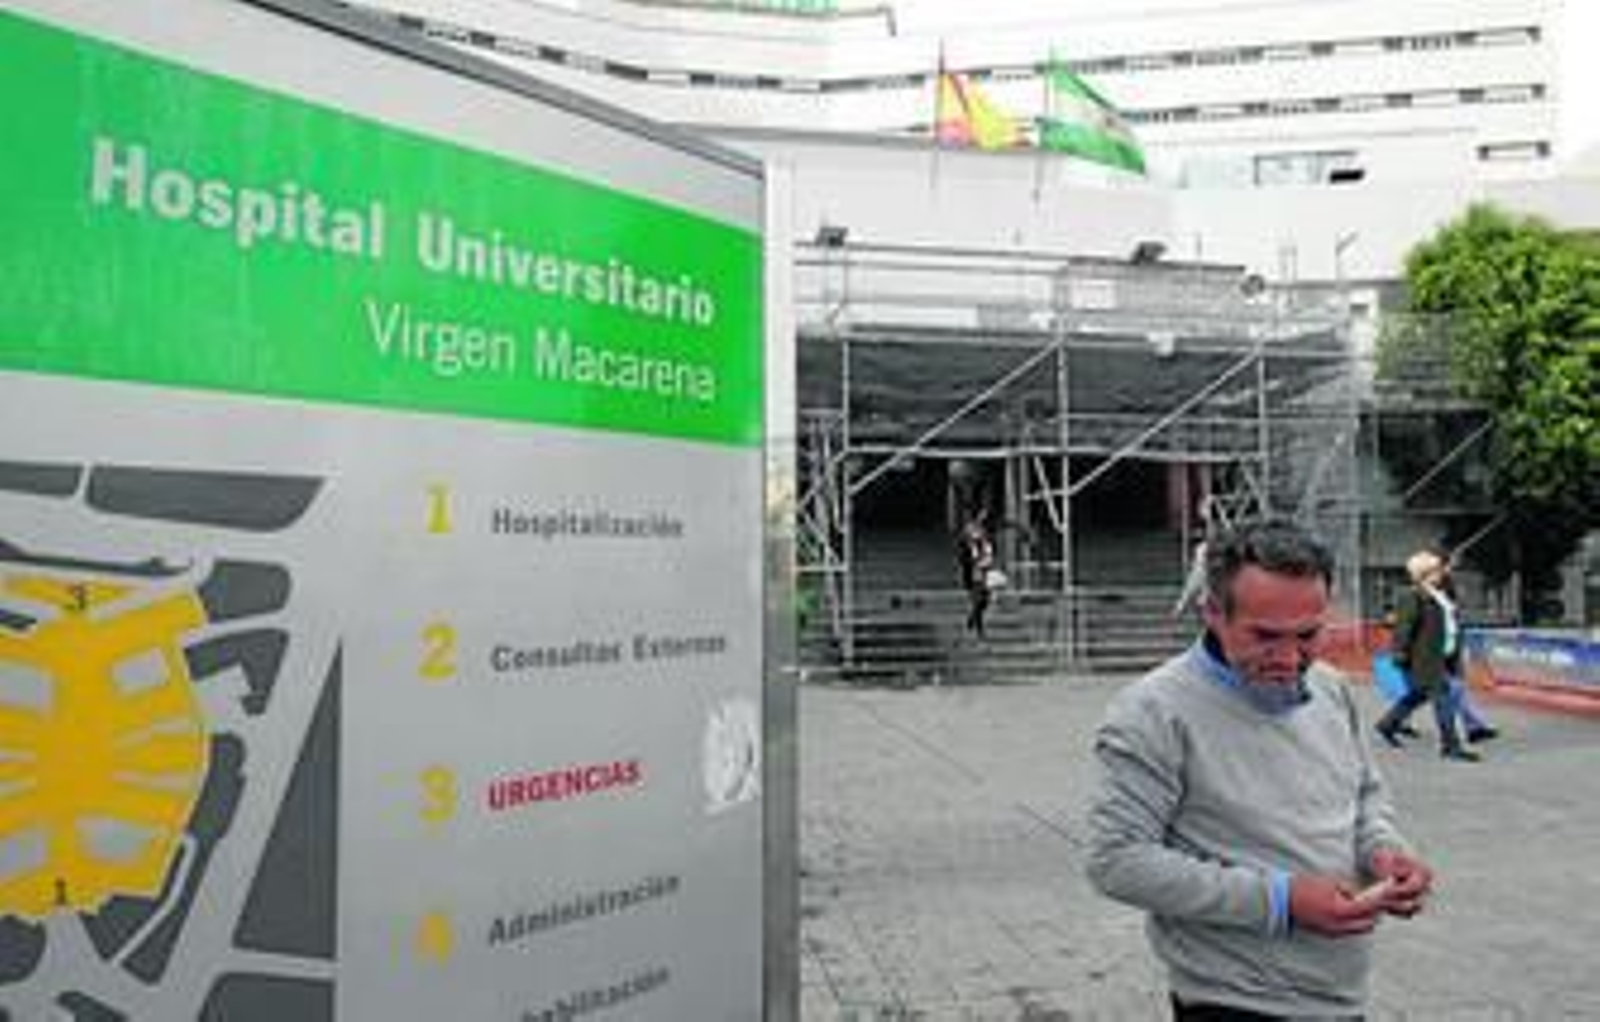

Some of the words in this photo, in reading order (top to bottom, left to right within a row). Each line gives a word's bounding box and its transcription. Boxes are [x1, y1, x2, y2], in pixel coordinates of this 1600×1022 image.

[91, 137, 385, 258] Hospital
[416, 211, 714, 327] Universitario
[364, 300, 516, 376] Virgen
[534, 329, 716, 403] Macarena
[426, 484, 453, 534] 1
[418, 622, 457, 679] 2
[491, 641, 623, 674] Consultas
[419, 766, 455, 822] 3
[488, 761, 641, 811] URGENCIAS
